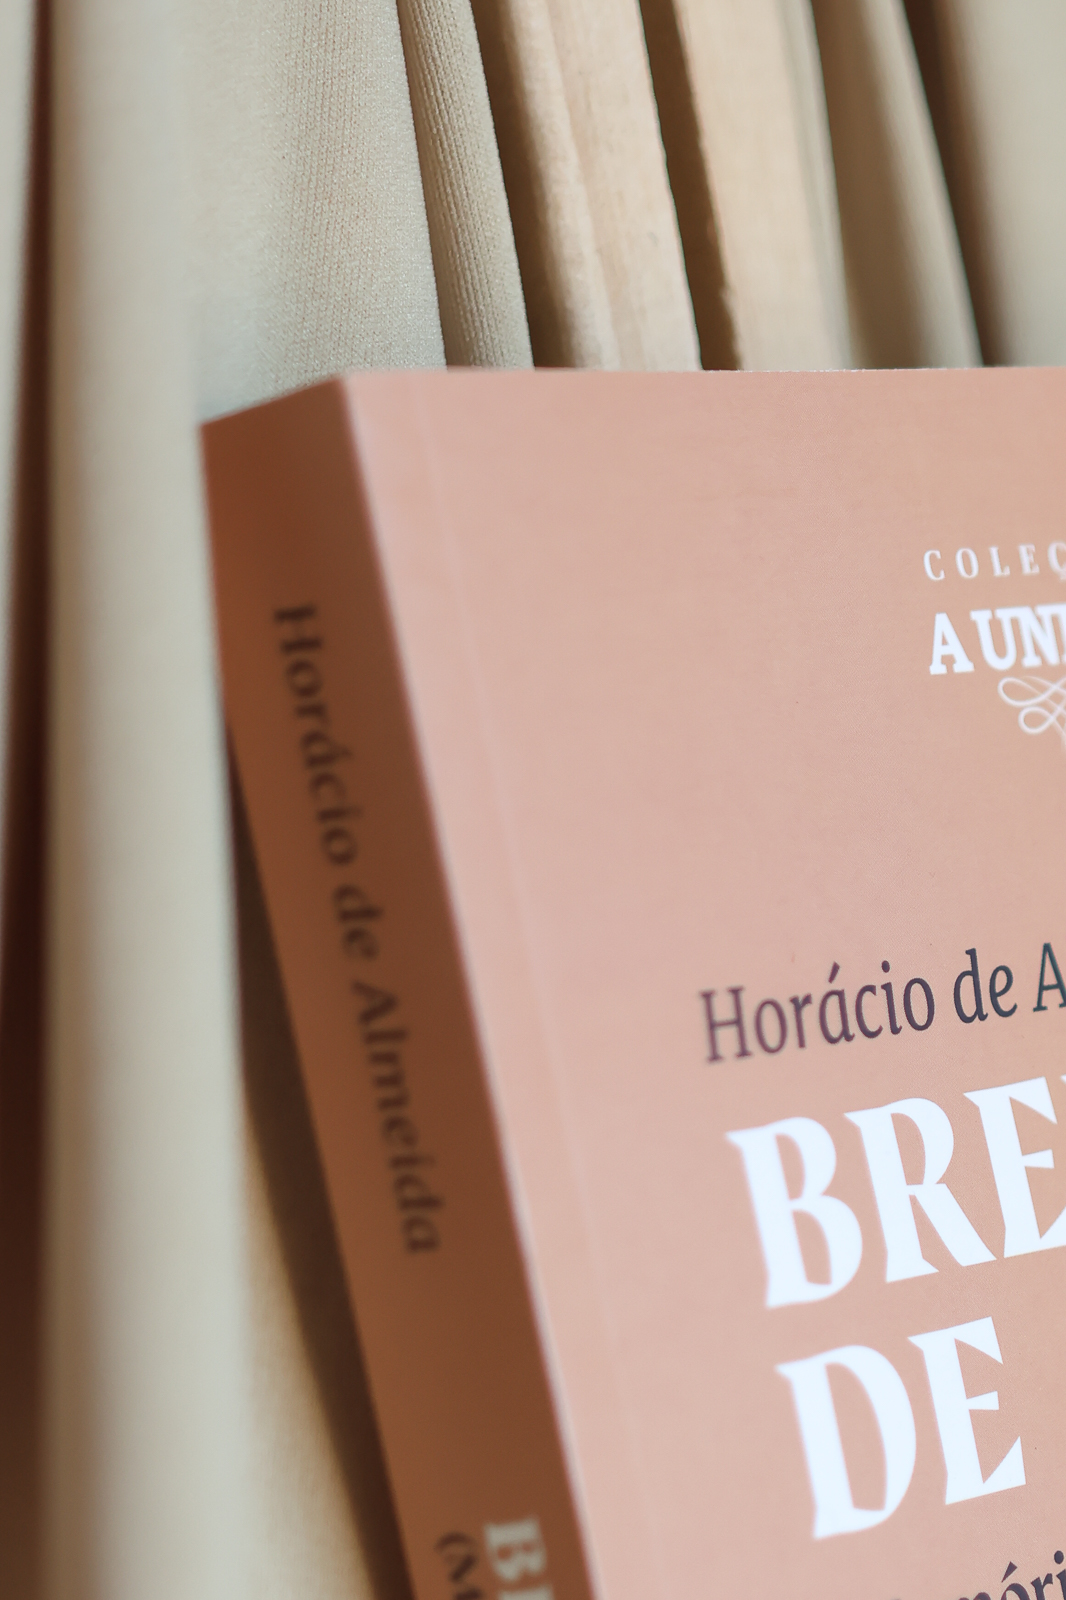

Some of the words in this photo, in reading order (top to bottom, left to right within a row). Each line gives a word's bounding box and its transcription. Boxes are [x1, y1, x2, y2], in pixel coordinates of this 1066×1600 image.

[929, 612, 974, 674] A
[273, 603, 362, 867] Horácio
[331, 882, 384, 961] de
[699, 960, 935, 1063] Horácio
[953, 948, 1017, 1024] de
[352, 979, 444, 1255] Almeida
[775, 1316, 1026, 1540] DE
